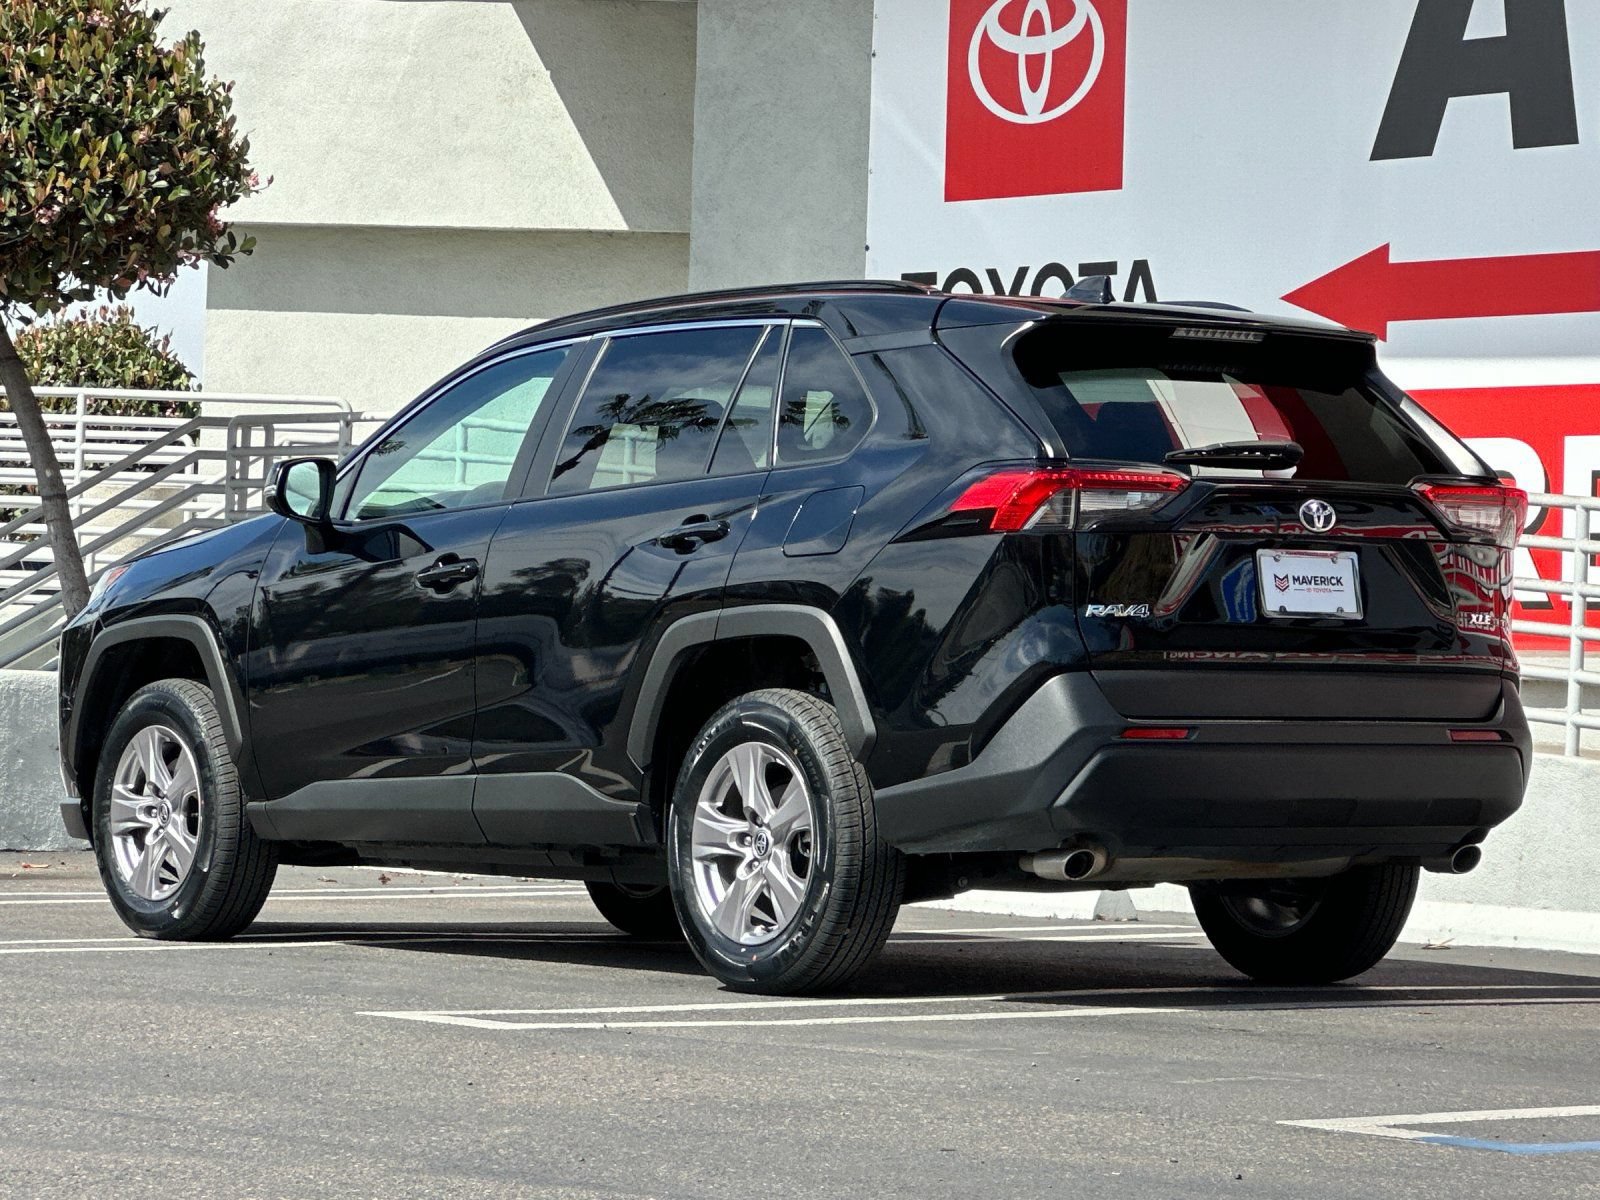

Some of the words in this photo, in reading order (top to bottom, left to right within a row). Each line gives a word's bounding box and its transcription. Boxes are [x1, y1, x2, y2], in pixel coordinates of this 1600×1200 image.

[900, 259, 1158, 303] OYOA
[1292, 575, 1344, 587] MAVERICK
[1085, 603, 1150, 618] RAV4
[1469, 613, 1493, 625] XLE
